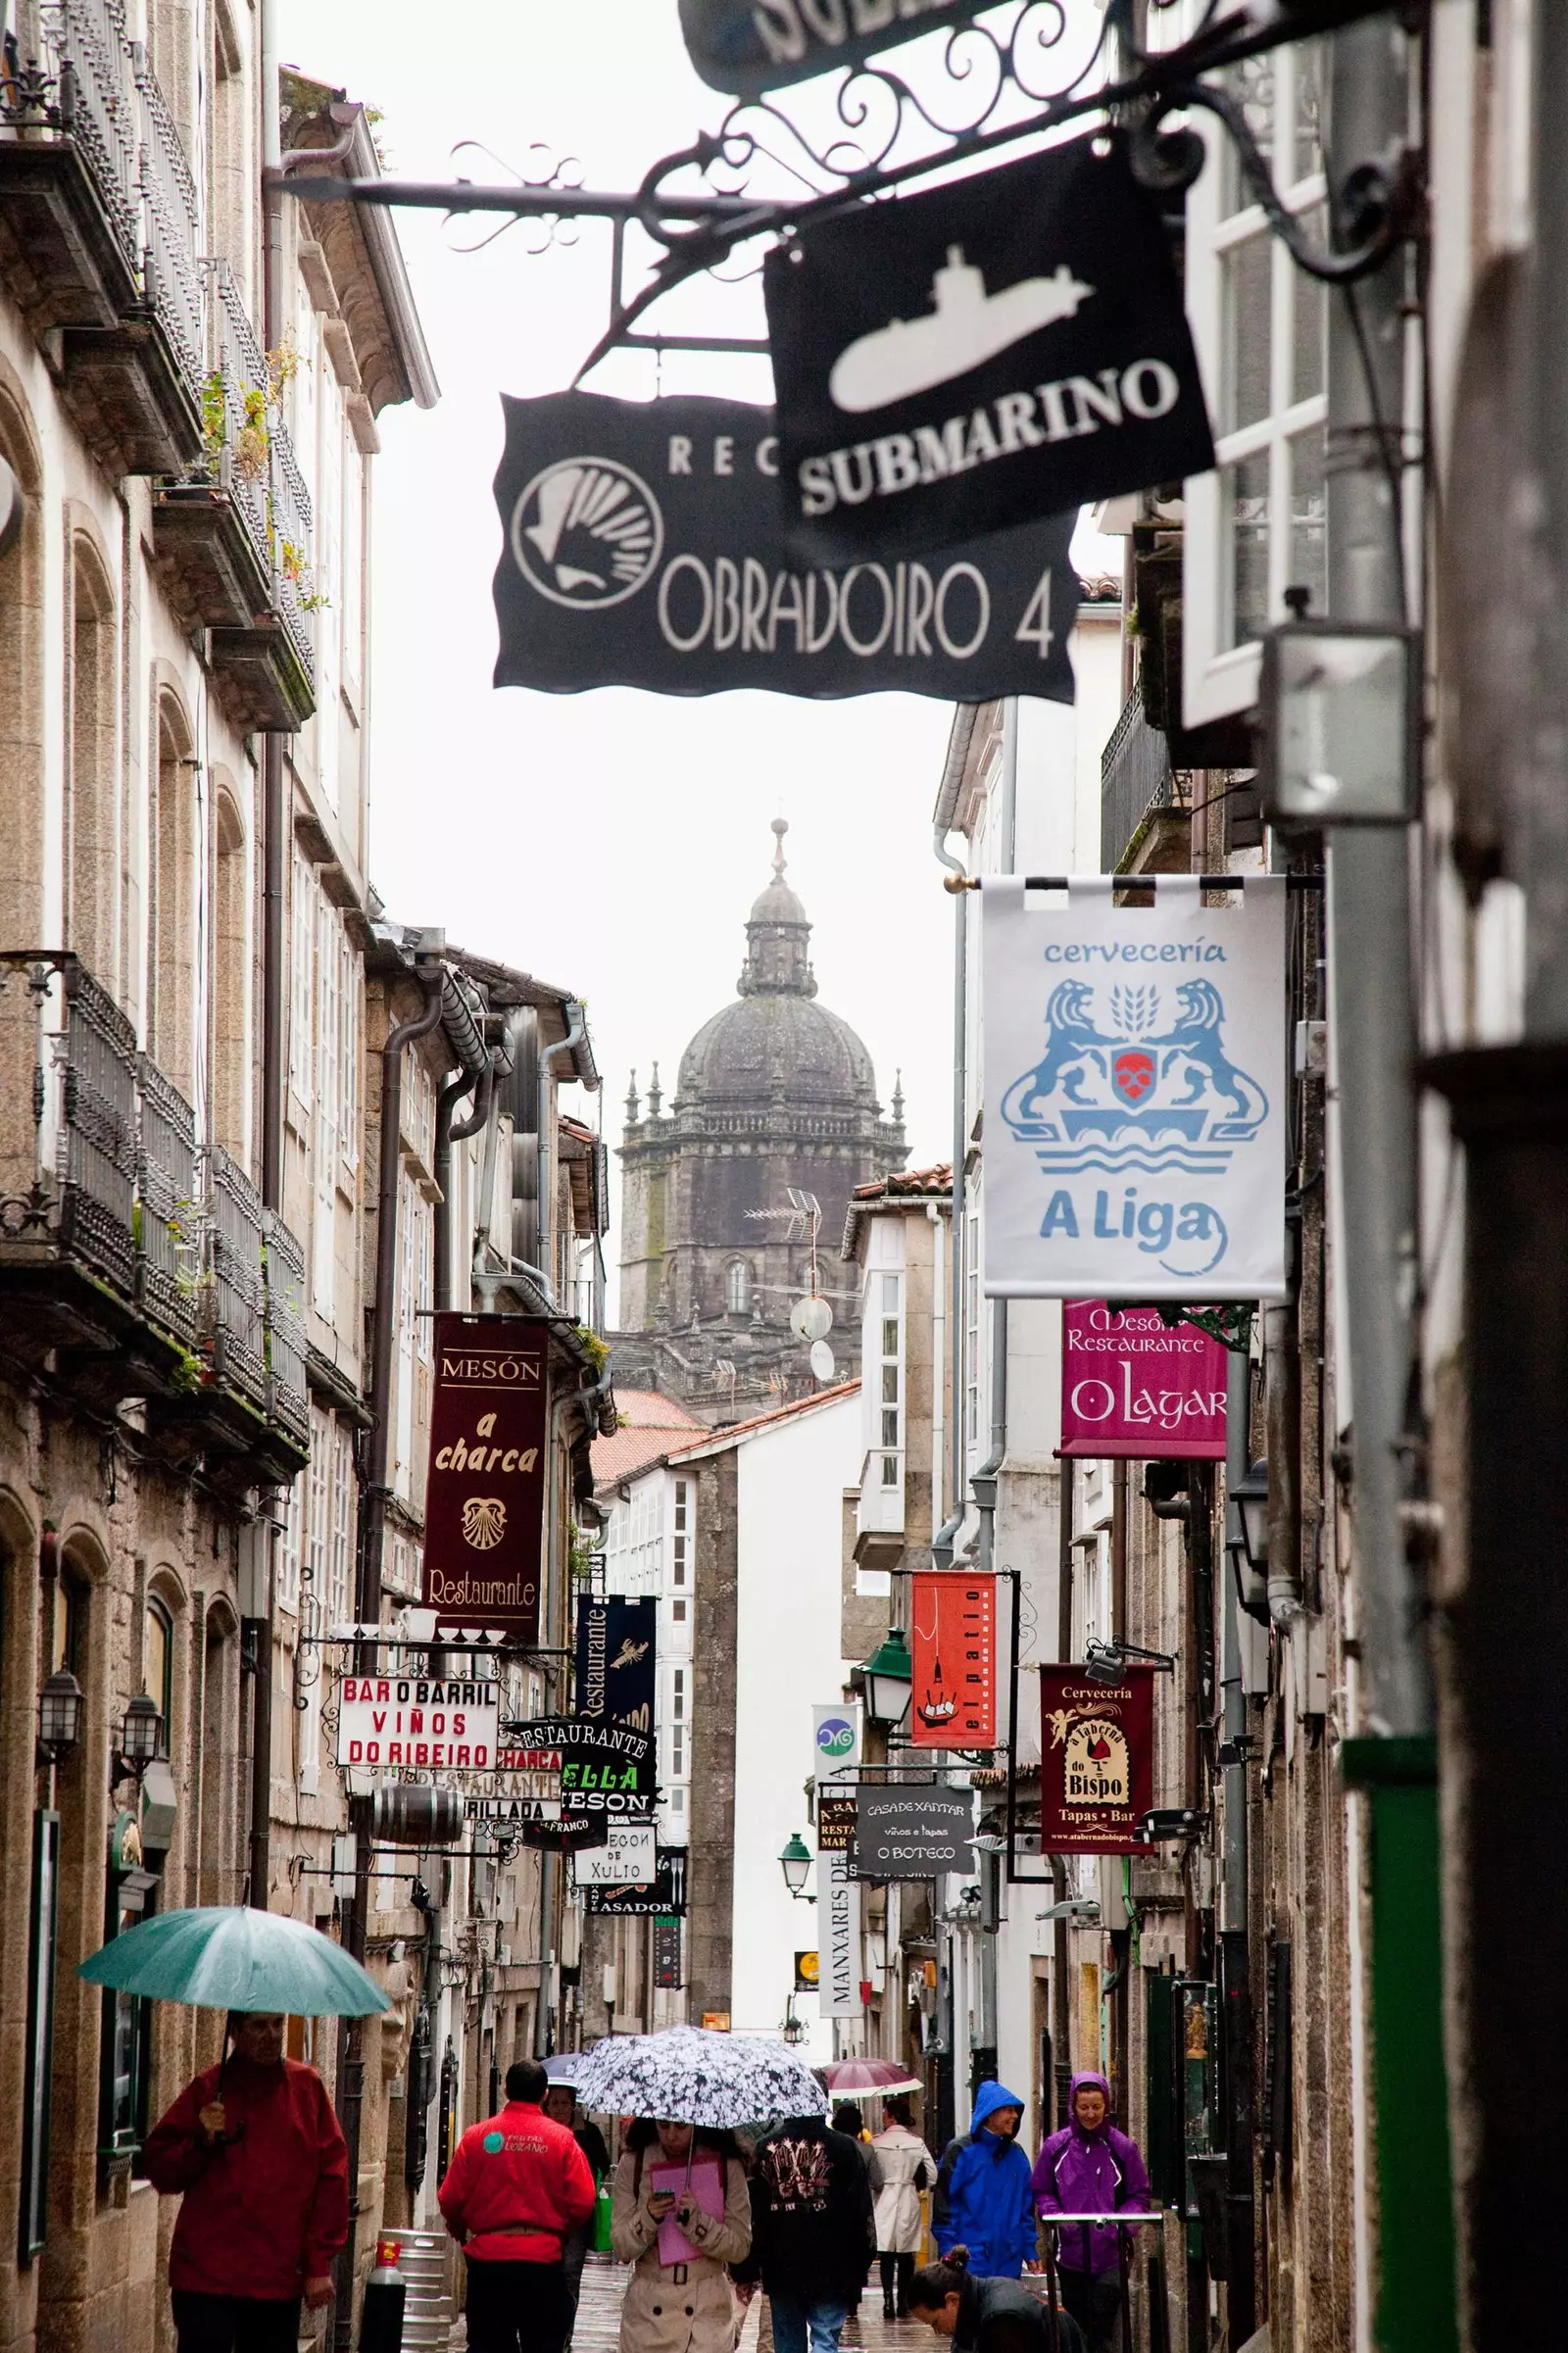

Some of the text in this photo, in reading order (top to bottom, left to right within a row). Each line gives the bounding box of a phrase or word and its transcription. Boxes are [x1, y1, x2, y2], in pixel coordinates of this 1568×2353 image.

[799, 358, 1179, 515] SUBMARINO
[659, 553, 1054, 660] OBRADOIRO 4
[1044, 937, 1227, 964] cervecería
[1040, 1188, 1228, 1275] A Liga
[1090, 1309, 1174, 1332] Mesó
[440, 1355, 542, 1381] MESÓN
[1071, 1379, 1115, 1421] O
[476, 1412, 498, 1438] a
[435, 1437, 539, 1473] charca
[428, 1569, 536, 1606] Restaurante
[963, 1591, 982, 1684] patio
[343, 1679, 497, 1706] BAR O BARRIL
[1061, 1686, 1133, 1700] Cervecería
[371, 1708, 466, 1737] VIÑOS
[349, 1740, 488, 1767] DO RIBEIRO
[520, 1724, 649, 1760] ESTAURANTE
[1071, 1760, 1085, 1772] do
[1069, 1775, 1123, 1799] Bispo
[464, 1800, 545, 1820] RILLADA
[1058, 1809, 1136, 1825] Tapas Bar
[608, 1851, 621, 1860] DE
[878, 1846, 956, 1860] O BOTECO
[591, 1862, 641, 1879] XULIO
[601, 1902, 674, 1912] ASADOR
[830, 1889, 851, 2004] MANXARES
[504, 2141, 549, 2154] LOZANO
